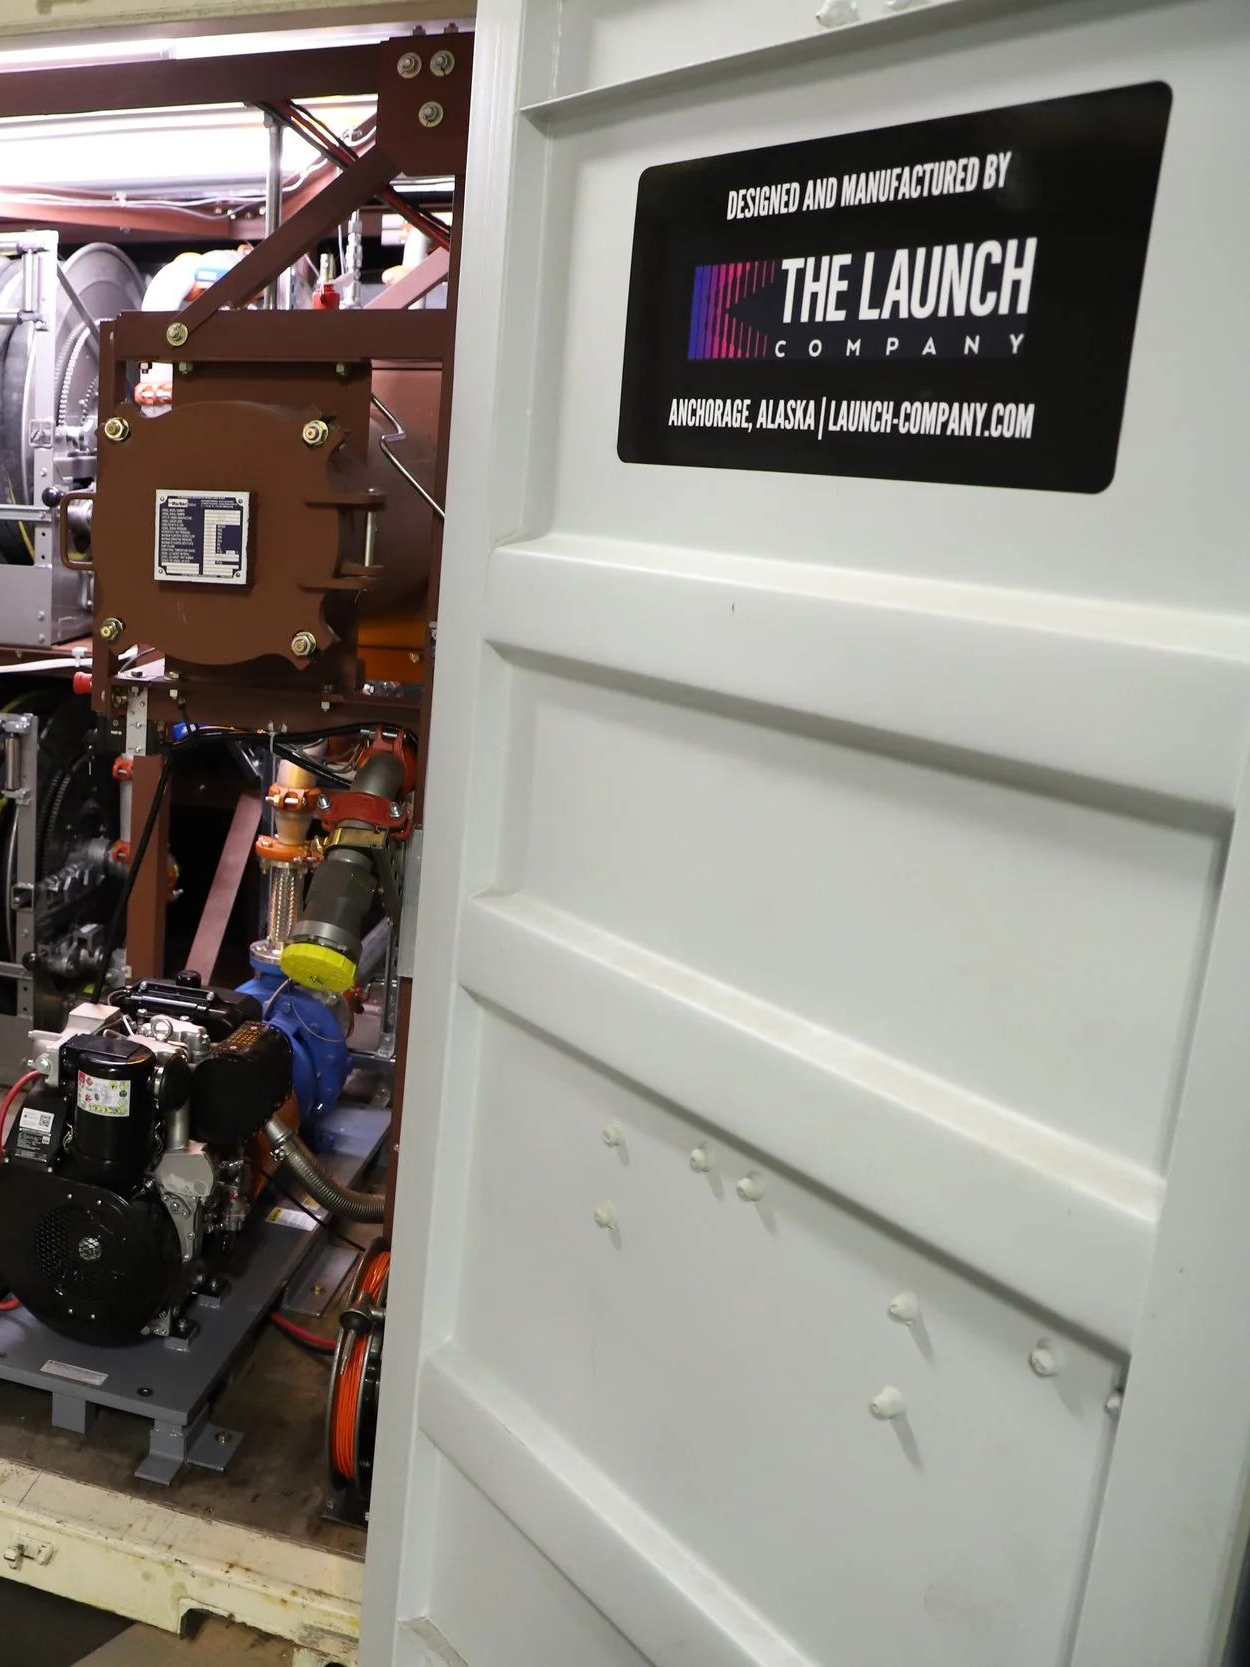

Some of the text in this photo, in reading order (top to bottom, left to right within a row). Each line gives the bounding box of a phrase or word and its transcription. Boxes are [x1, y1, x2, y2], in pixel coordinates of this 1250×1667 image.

[726, 151, 1012, 221] DESIGNED AND MANUFACTURED BY
[781, 237, 1038, 324] THE LAUNCH
[774, 333, 1024, 358] COMPANY
[668, 398, 753, 433] ANCHORAGE,
[828, 400, 1035, 439] LAUNCH-COMPANY.COM
